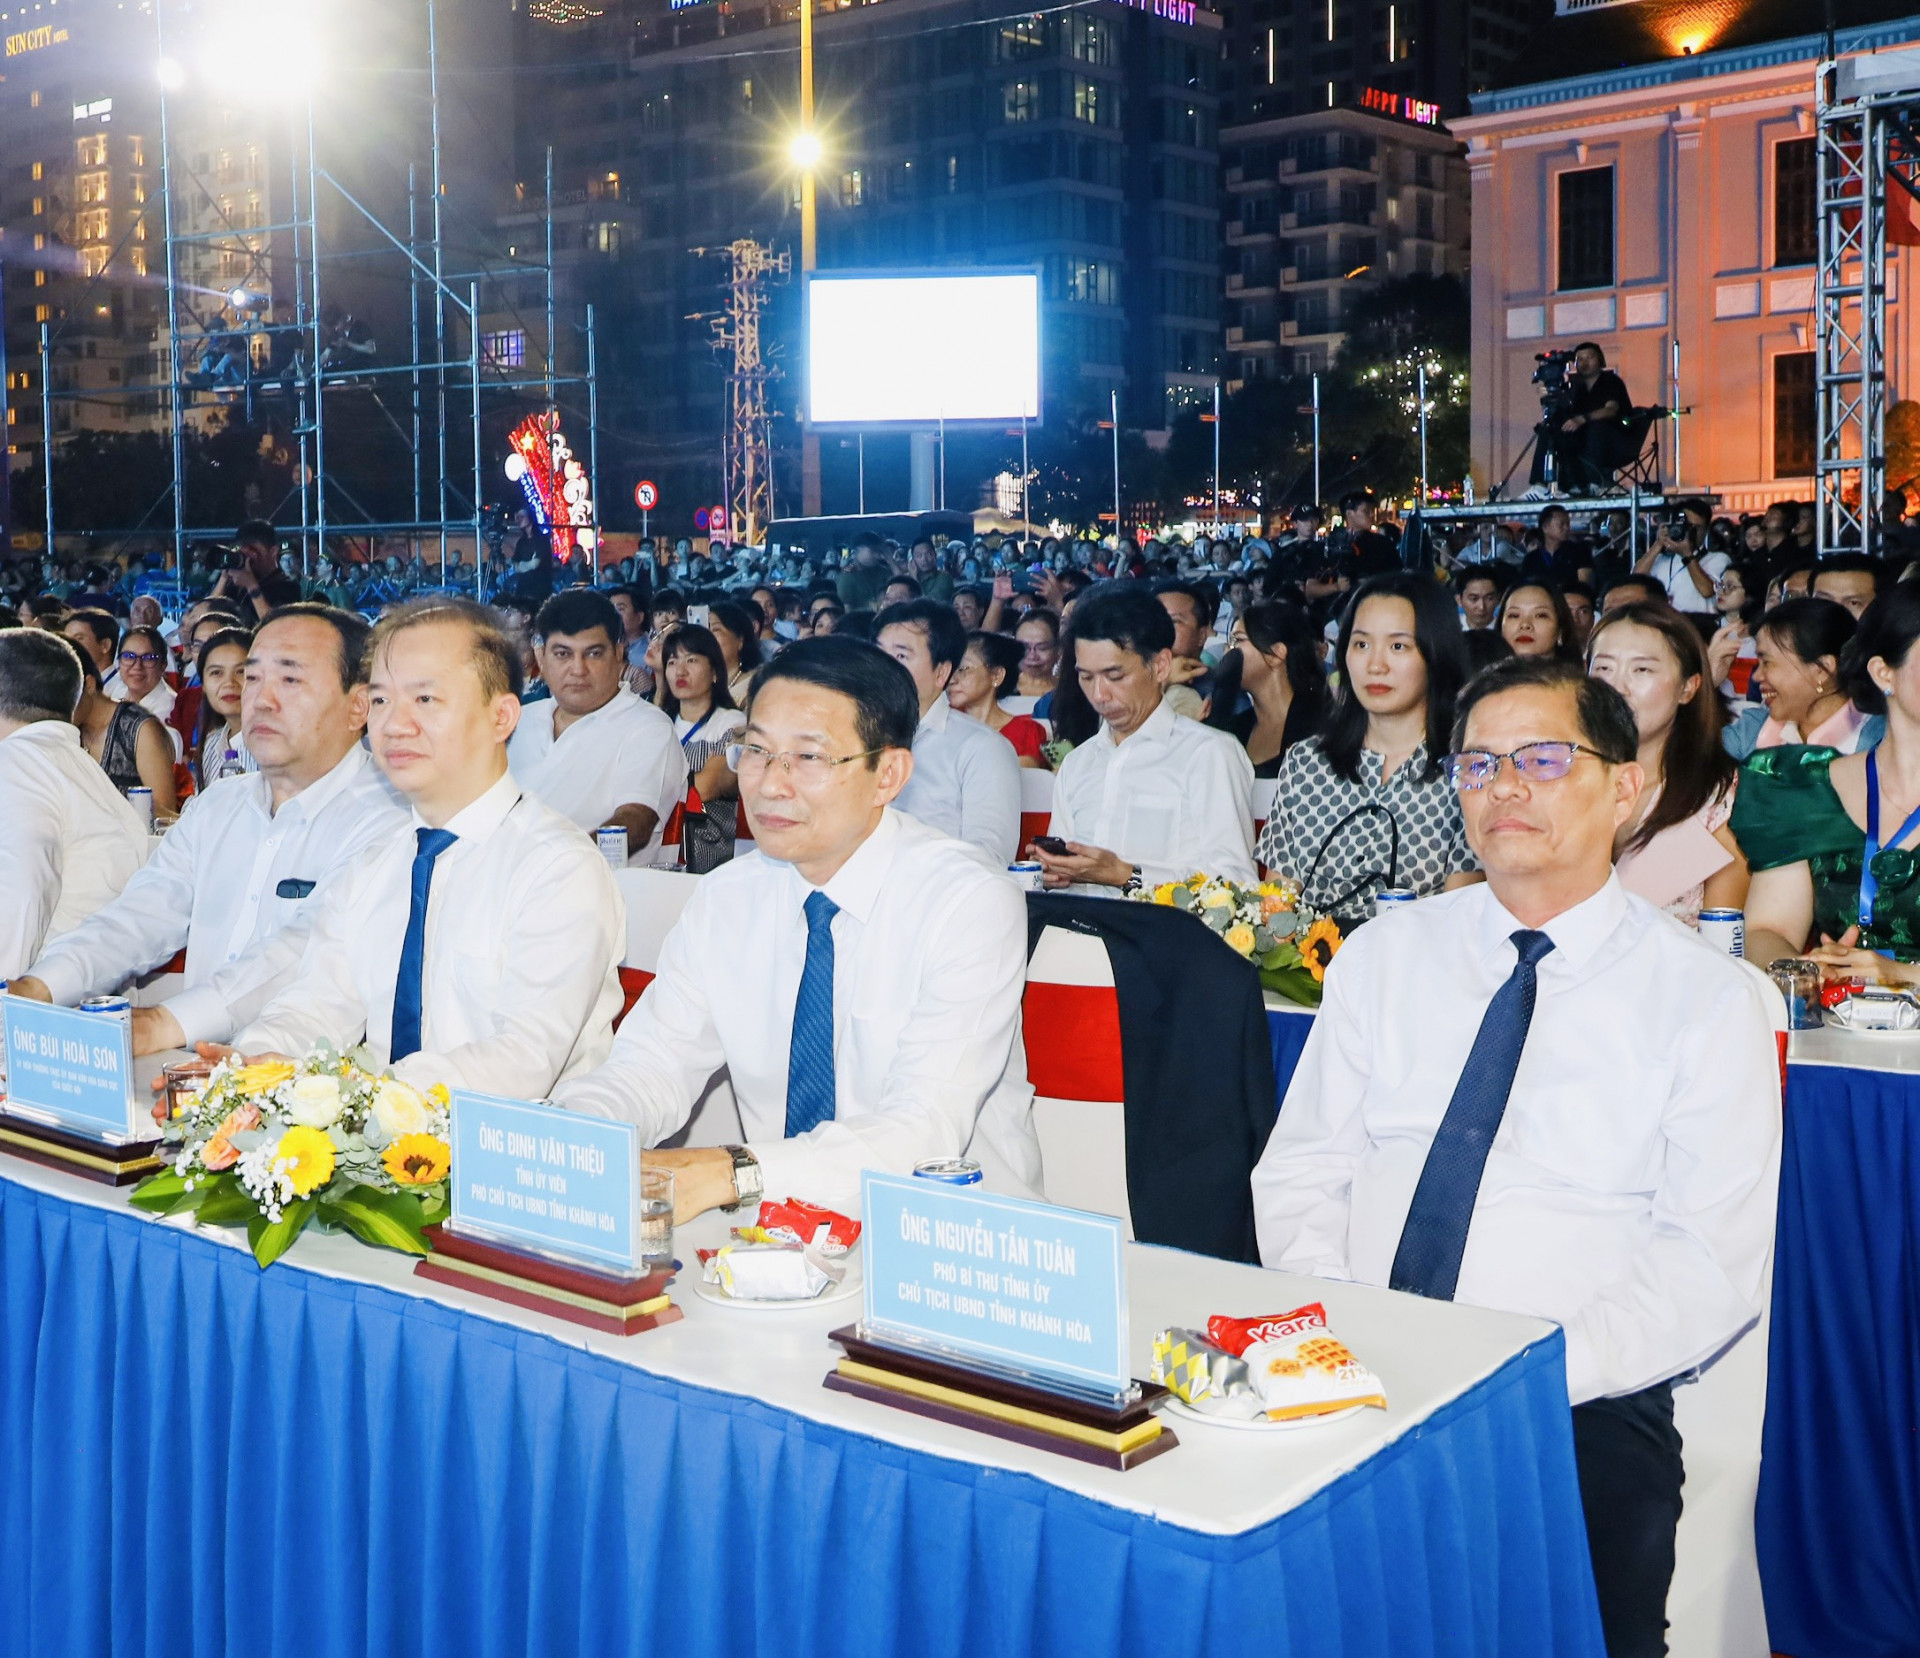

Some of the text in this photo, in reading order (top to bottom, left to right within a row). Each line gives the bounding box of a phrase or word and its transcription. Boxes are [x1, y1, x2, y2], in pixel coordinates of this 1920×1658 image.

[1154, 0, 1196, 26] LIGHT
[6, 32, 27, 57] SUN
[27, 24, 53, 51] CITY
[1405, 97, 1440, 126] LIGHT
[14, 1025, 118, 1073] ÔNG BÙI HOÀI SƠN
[479, 1122, 604, 1179] ÔNG ĐINH VĂN THIỆU
[471, 1183, 486, 1202] PHÓ
[488, 1185, 504, 1206] CHỦ
[507, 1191, 524, 1212] TỊCH
[526, 1195, 547, 1217] UBND
[569, 1204, 596, 1228] KHÁNH
[599, 1211, 615, 1233] HÒA
[549, 1176, 566, 1195] VIÊN
[900, 1207, 1075, 1276] ÔNG NGUYỄN TẤN TUÂN
[933, 1262, 1050, 1304] PHÓ BÍ THƯ TỈNH ỦY
[898, 1280, 1092, 1343] CHỦ TỊCH UBND TỈNH KHÁNH HÒA
